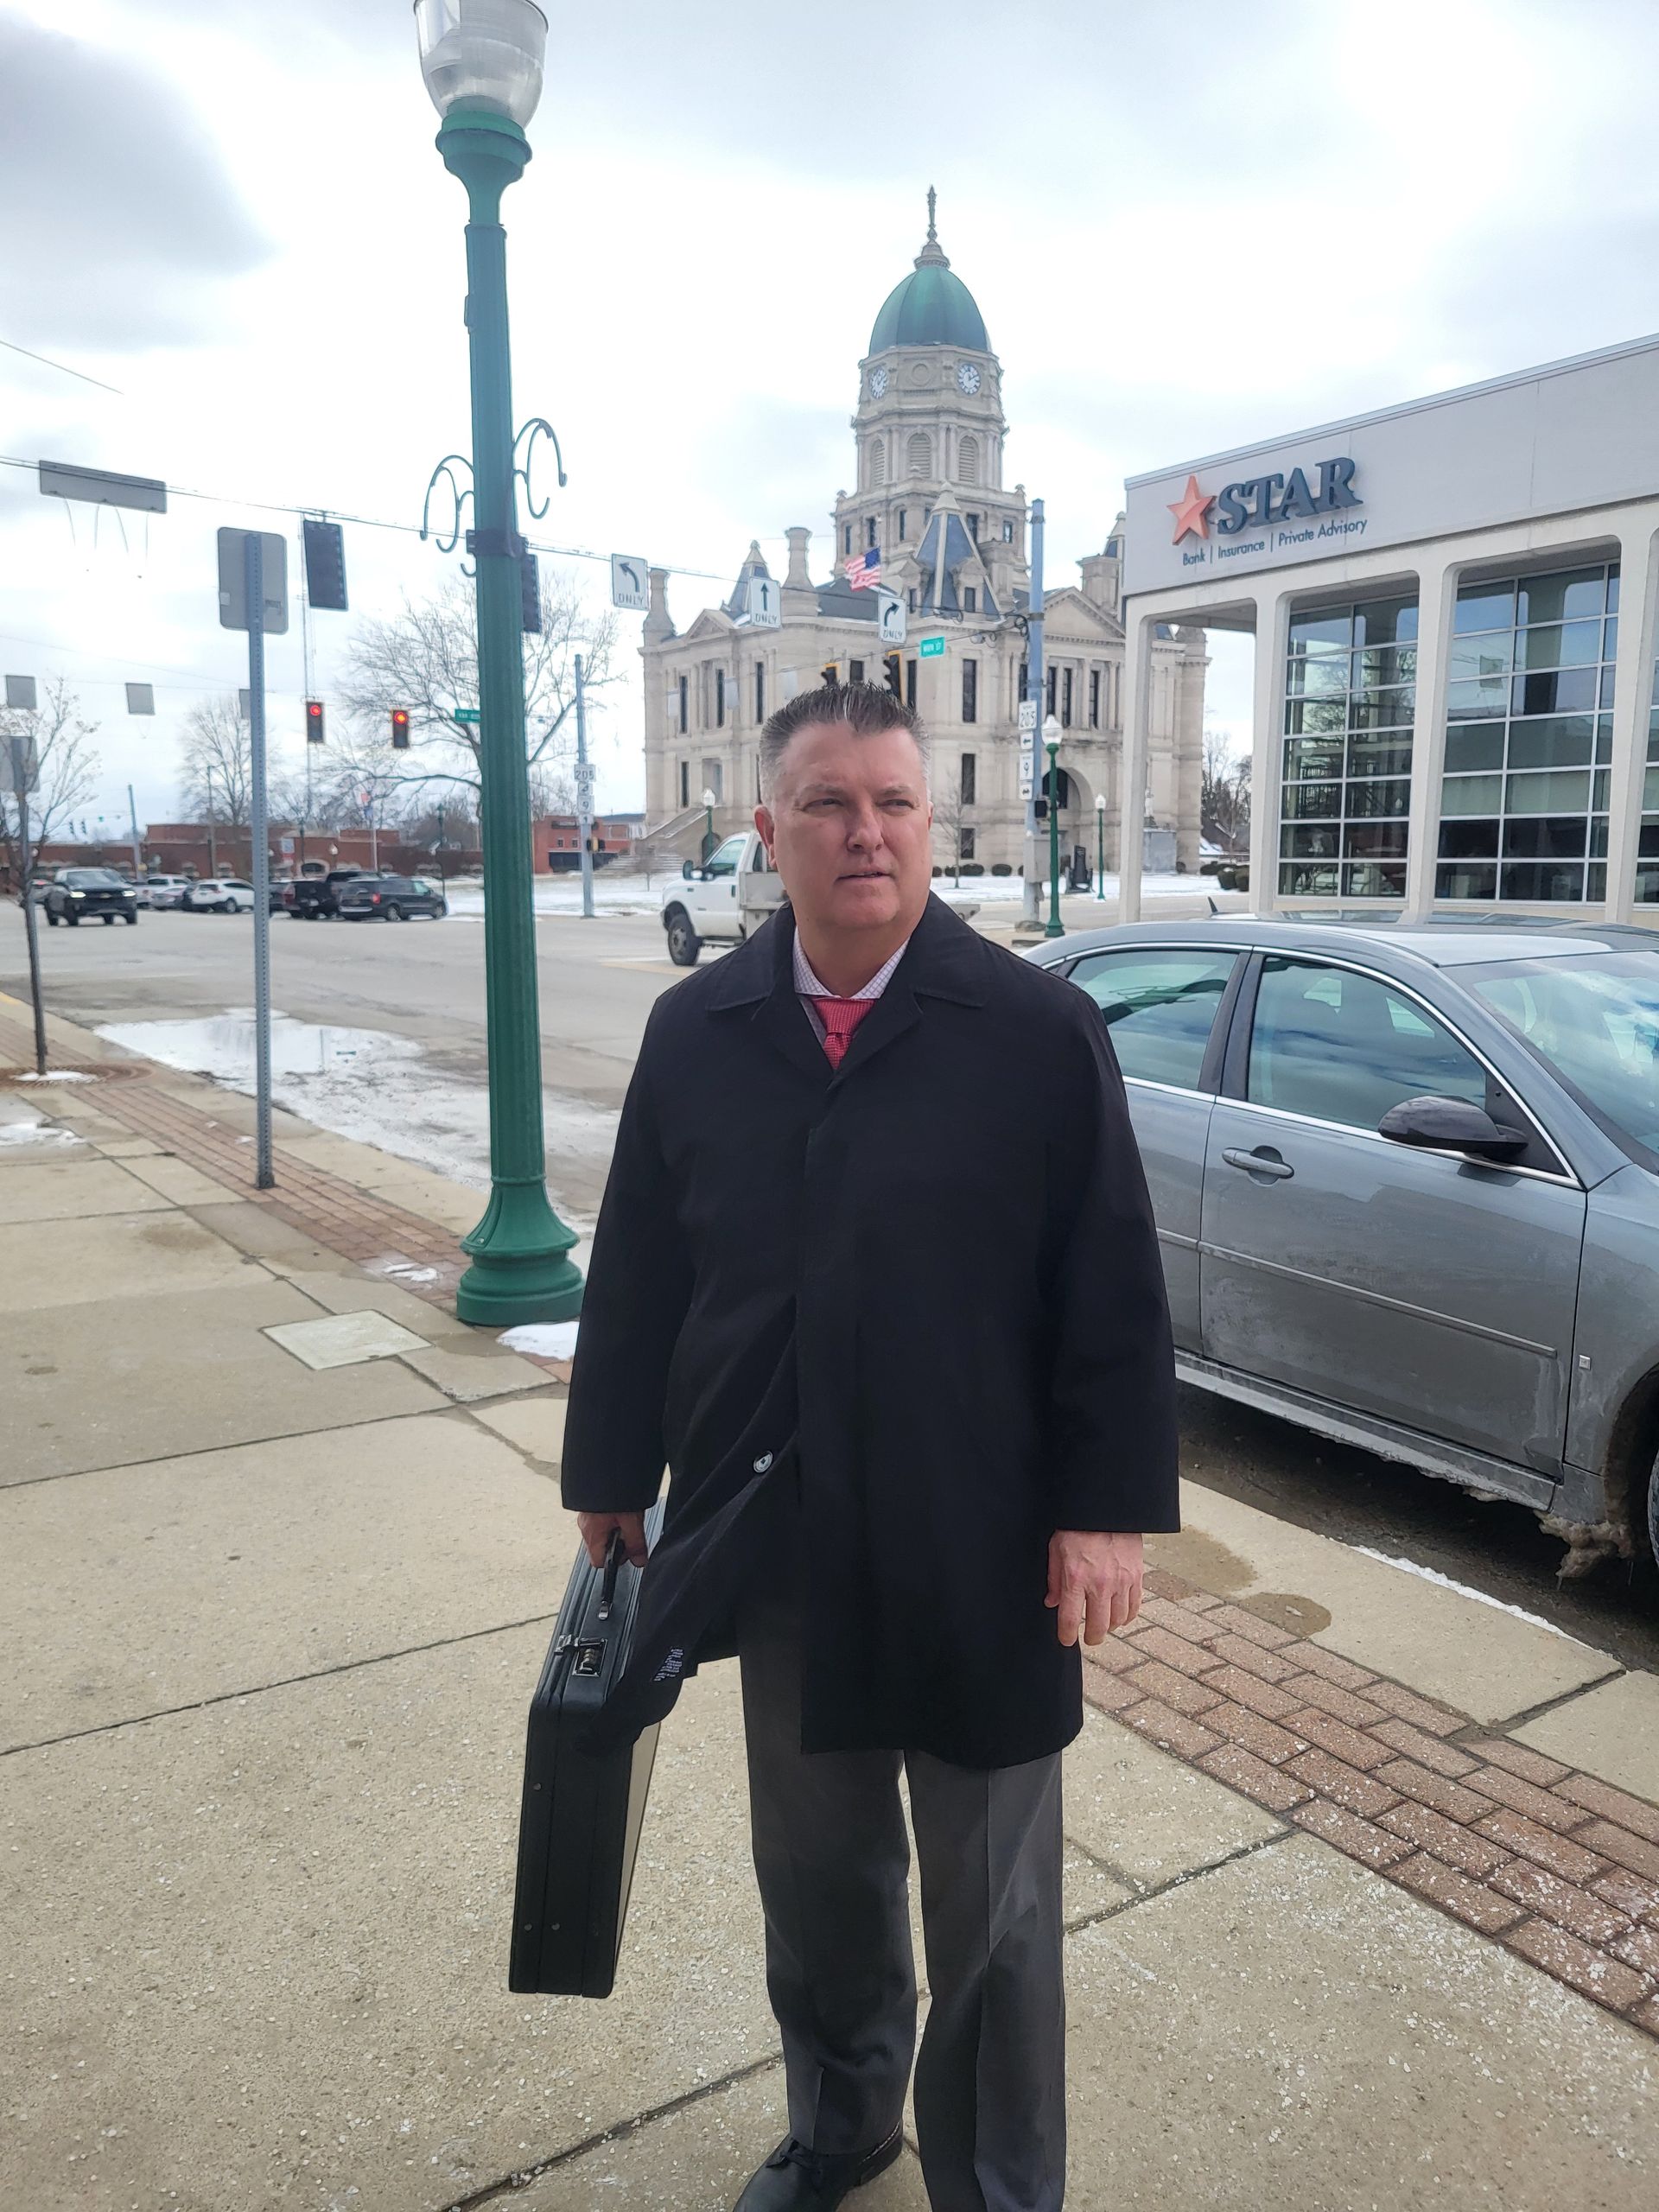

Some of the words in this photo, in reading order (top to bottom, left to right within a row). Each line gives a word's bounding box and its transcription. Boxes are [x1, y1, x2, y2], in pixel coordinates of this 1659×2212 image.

[1217, 457, 1363, 535] STAR
[1182, 548, 1205, 566] Bank
[1217, 541, 1265, 559] Insurance
[1278, 530, 1314, 546] Private
[1317, 519, 1368, 538] Advisory
[617, 593, 644, 605] ONLY
[755, 613, 777, 624] ONLY
[883, 630, 903, 639] ONLY
[1020, 711, 1035, 728] 205
[575, 770, 594, 780] 205
